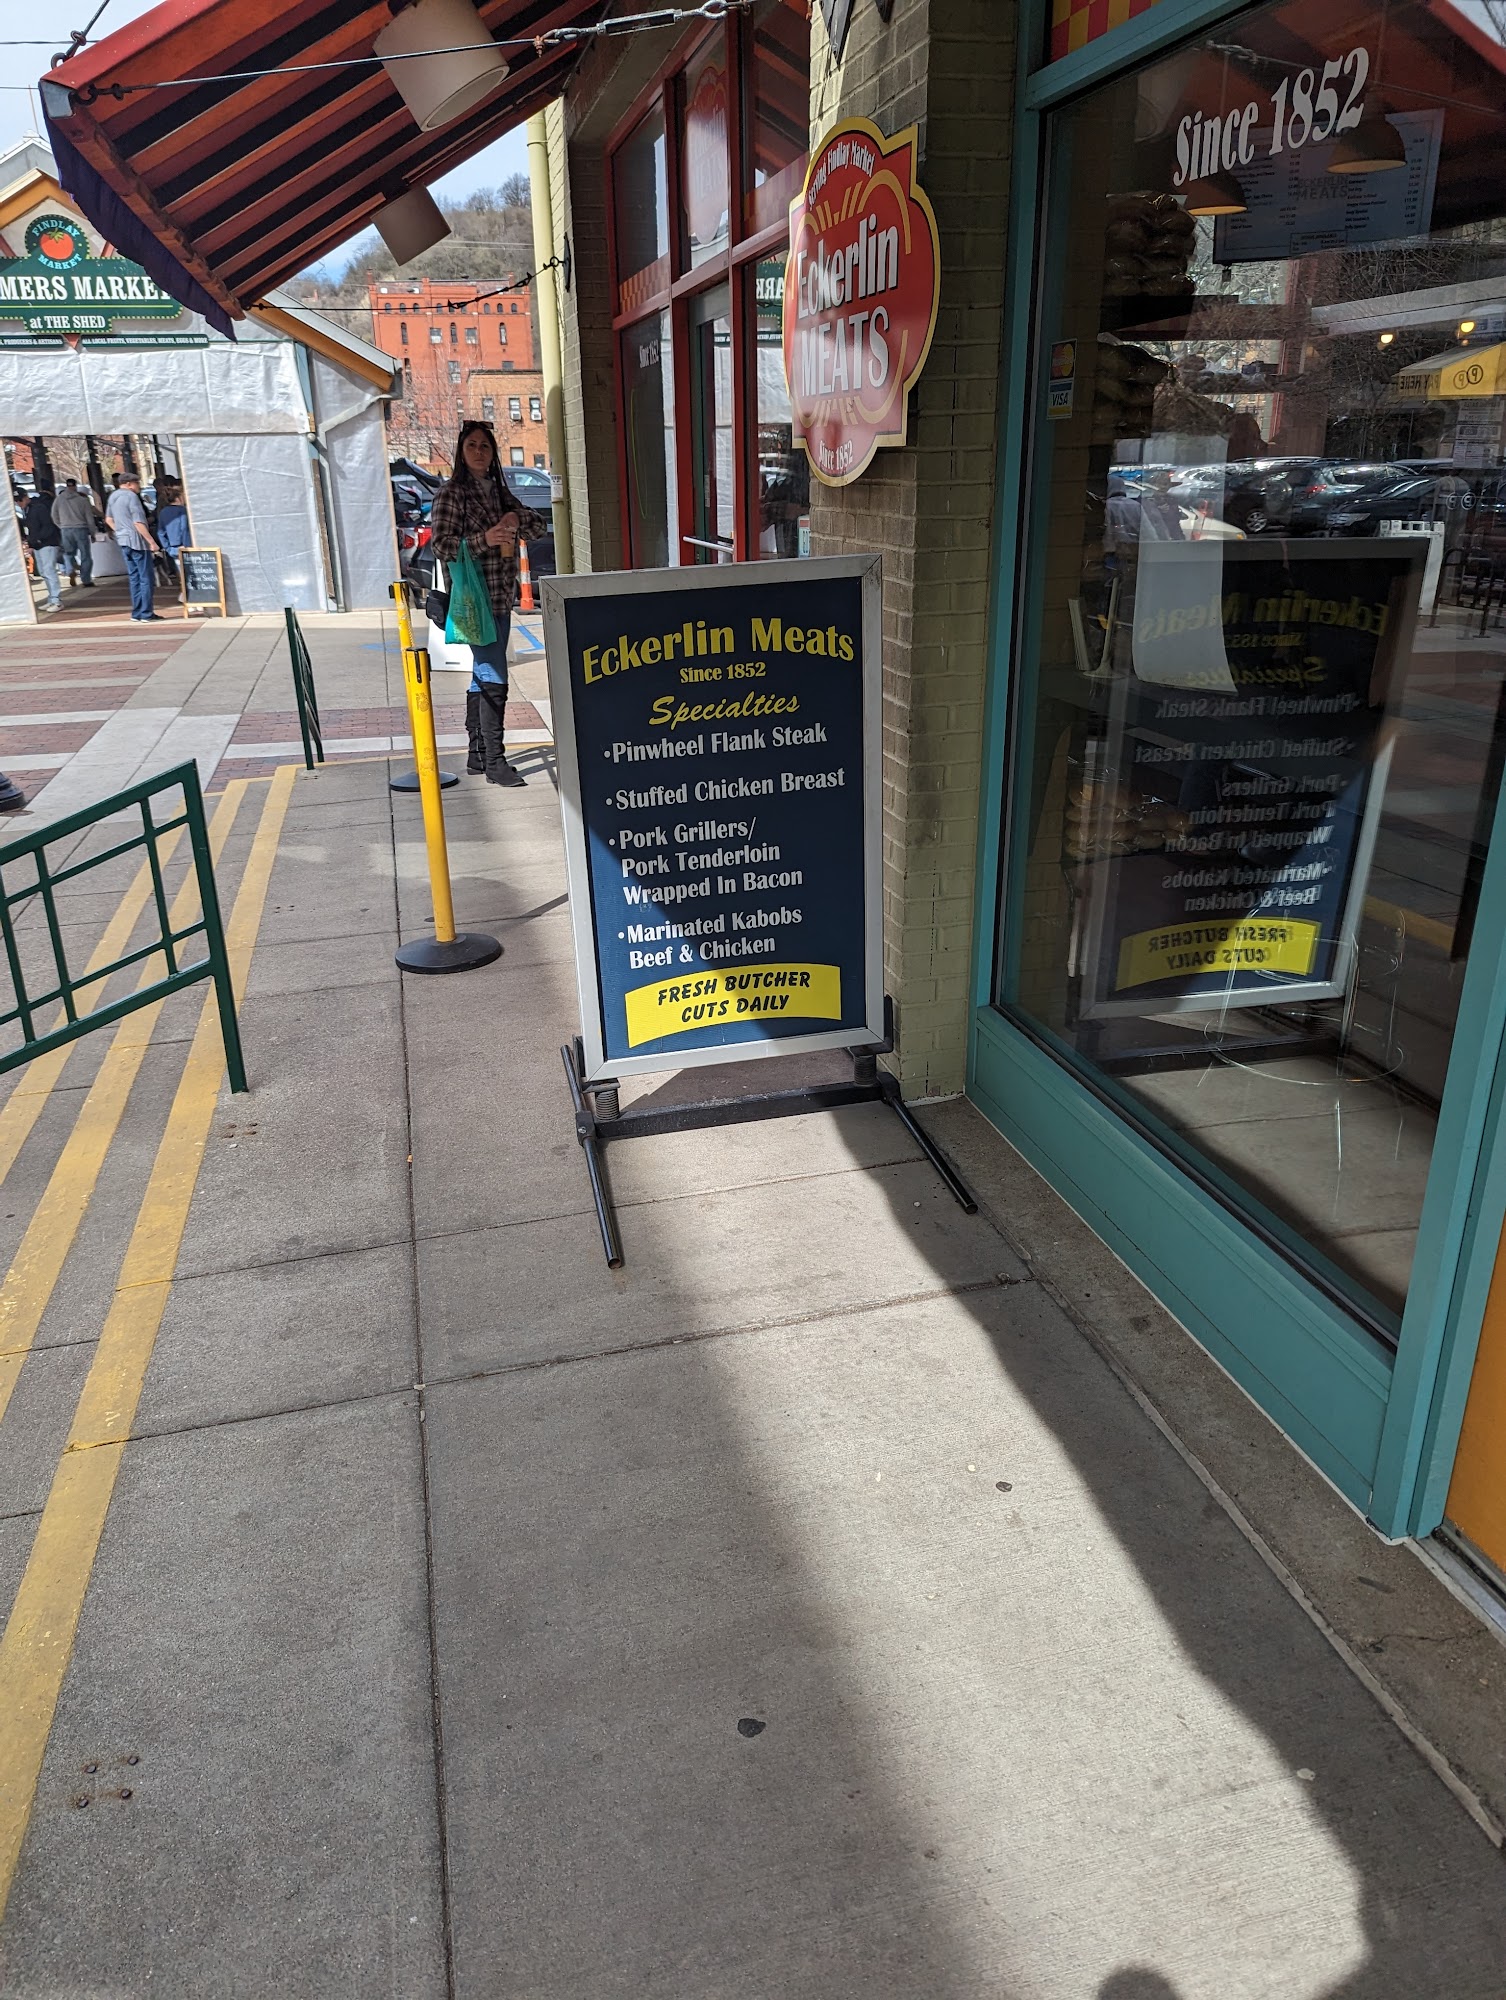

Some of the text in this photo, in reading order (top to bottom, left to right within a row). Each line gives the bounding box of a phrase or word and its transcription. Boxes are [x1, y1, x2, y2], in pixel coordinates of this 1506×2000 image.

[1173, 47, 1369, 187] Since 1852
[827, 141, 851, 175] Findlay
[850, 140, 876, 178] Market
[31, 219, 81, 238] FINDLAY
[37, 253, 83, 270] MARKET
[797, 213, 899, 320] Eckerlin
[29, 315, 106, 329] at THE SHED
[801, 305, 890, 397] MEATS
[1052, 392, 1069, 407] VISA
[819, 440, 853, 470] Since 1852
[583, 617, 854, 685] Eckerlin Meats
[679, 662, 767, 684] Since 1852
[649, 691, 801, 731] Specialties
[612, 722, 828, 763] Pinwheel Flank Steak
[615, 767, 845, 810] Stuffed Chicken Breast
[619, 816, 757, 850] Pork Grillers/
[621, 842, 780, 878] Pork Tenderloin
[622, 869, 803, 905] Wrapped In Bacon
[627, 906, 803, 944] Marinated Kabobs
[629, 936, 776, 970] Beef & Chicken
[657, 971, 812, 1006] FRESH BUTCHER
[681, 994, 790, 1023] CUTS DAILY
